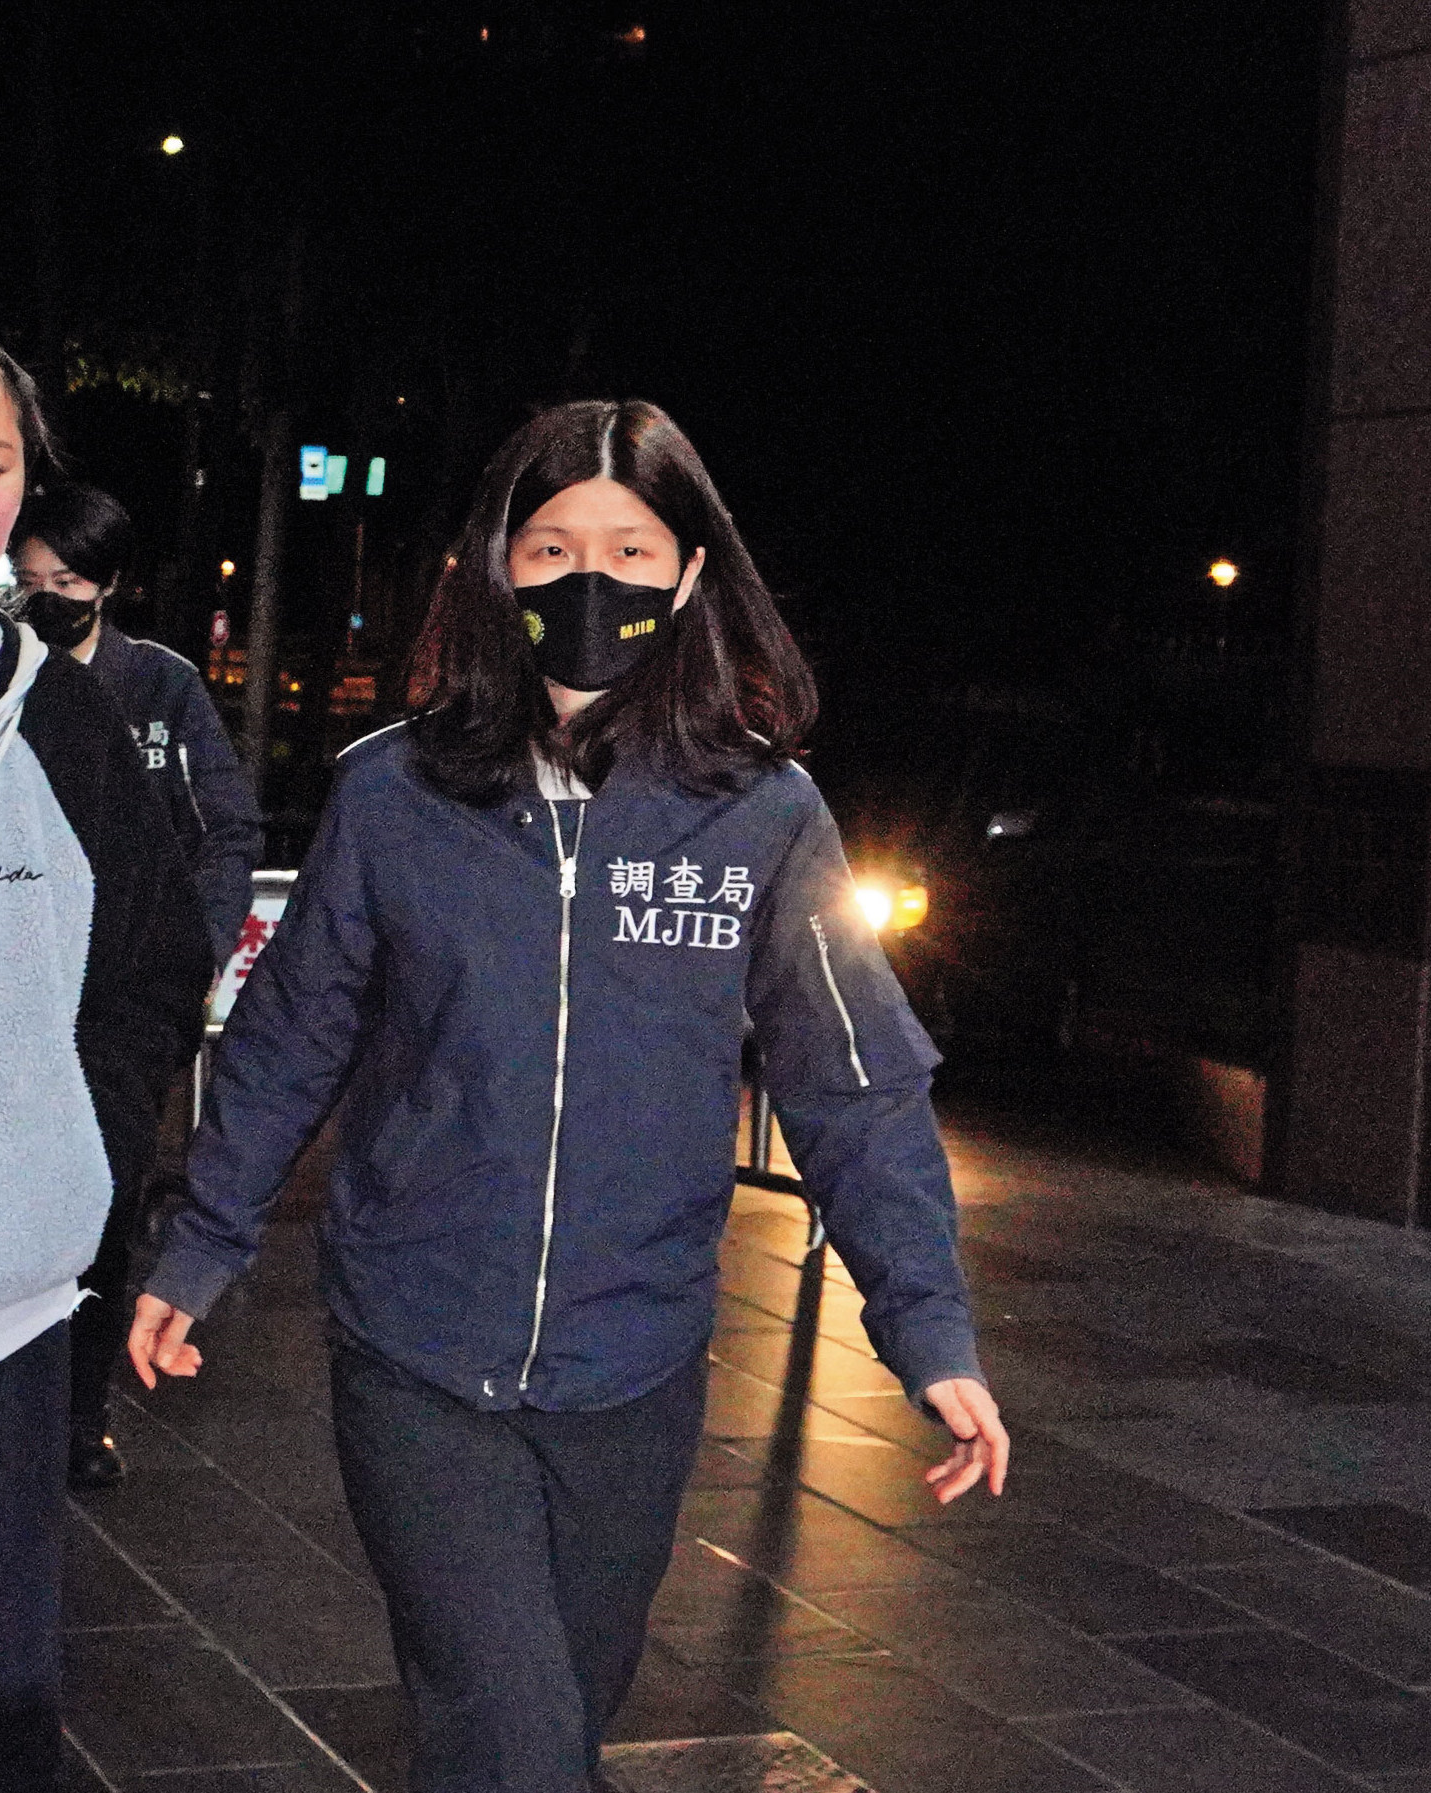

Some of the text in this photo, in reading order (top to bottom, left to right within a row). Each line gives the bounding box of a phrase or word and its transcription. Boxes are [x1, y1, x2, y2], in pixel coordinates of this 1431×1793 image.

[620, 618, 656, 640] MJIB
[128, 720, 169, 746] 局
[608, 856, 755, 912] 調查局
[612, 905, 742, 951] MJIB
